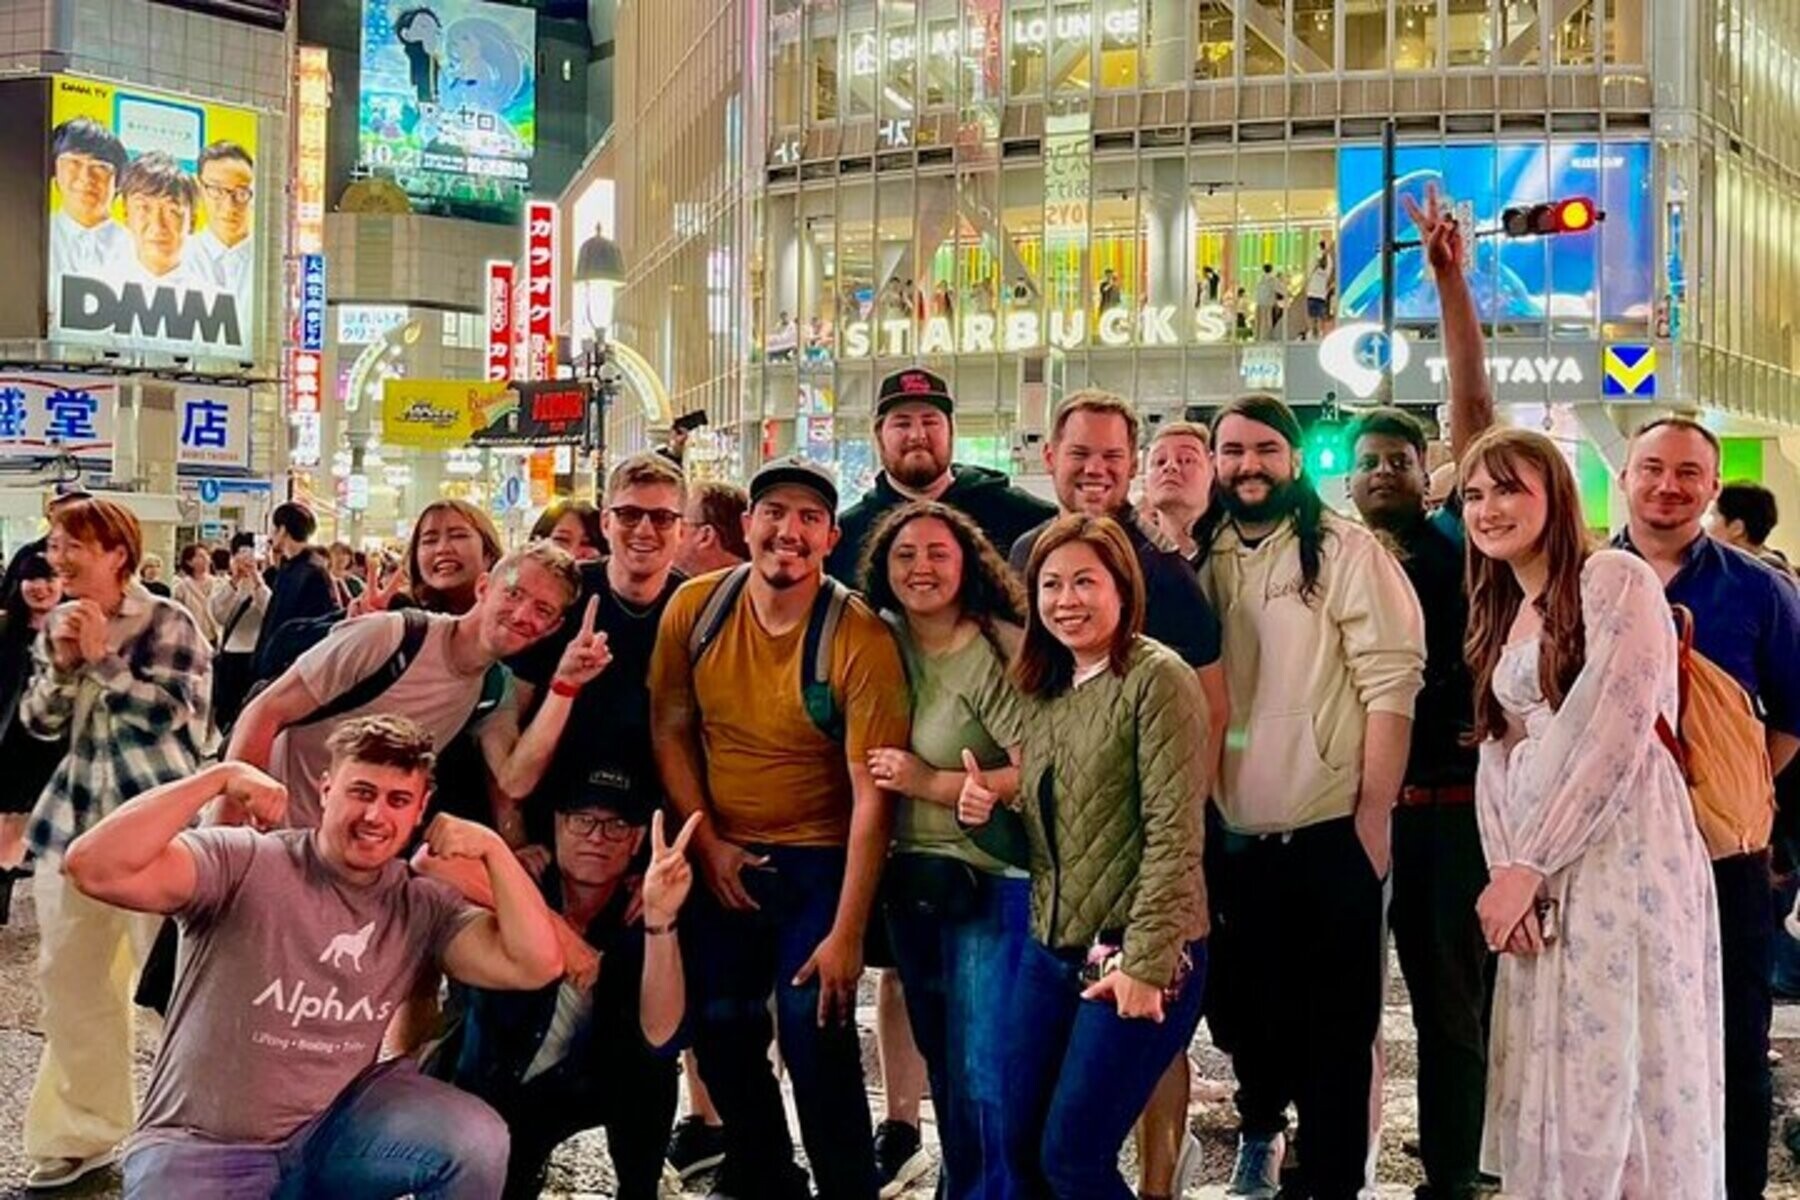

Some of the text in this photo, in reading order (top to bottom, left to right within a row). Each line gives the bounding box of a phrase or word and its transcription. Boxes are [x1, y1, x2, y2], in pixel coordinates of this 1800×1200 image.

[889, 26, 986, 61] SHARE
[1015, 10, 1138, 45] LOUNGE
[530, 219, 551, 322] カラオケ
[60, 274, 242, 347] DMM
[844, 304, 1228, 358] STARBUCKS
[1425, 357, 1583, 384] TTAYA
[181, 399, 229, 447] 店
